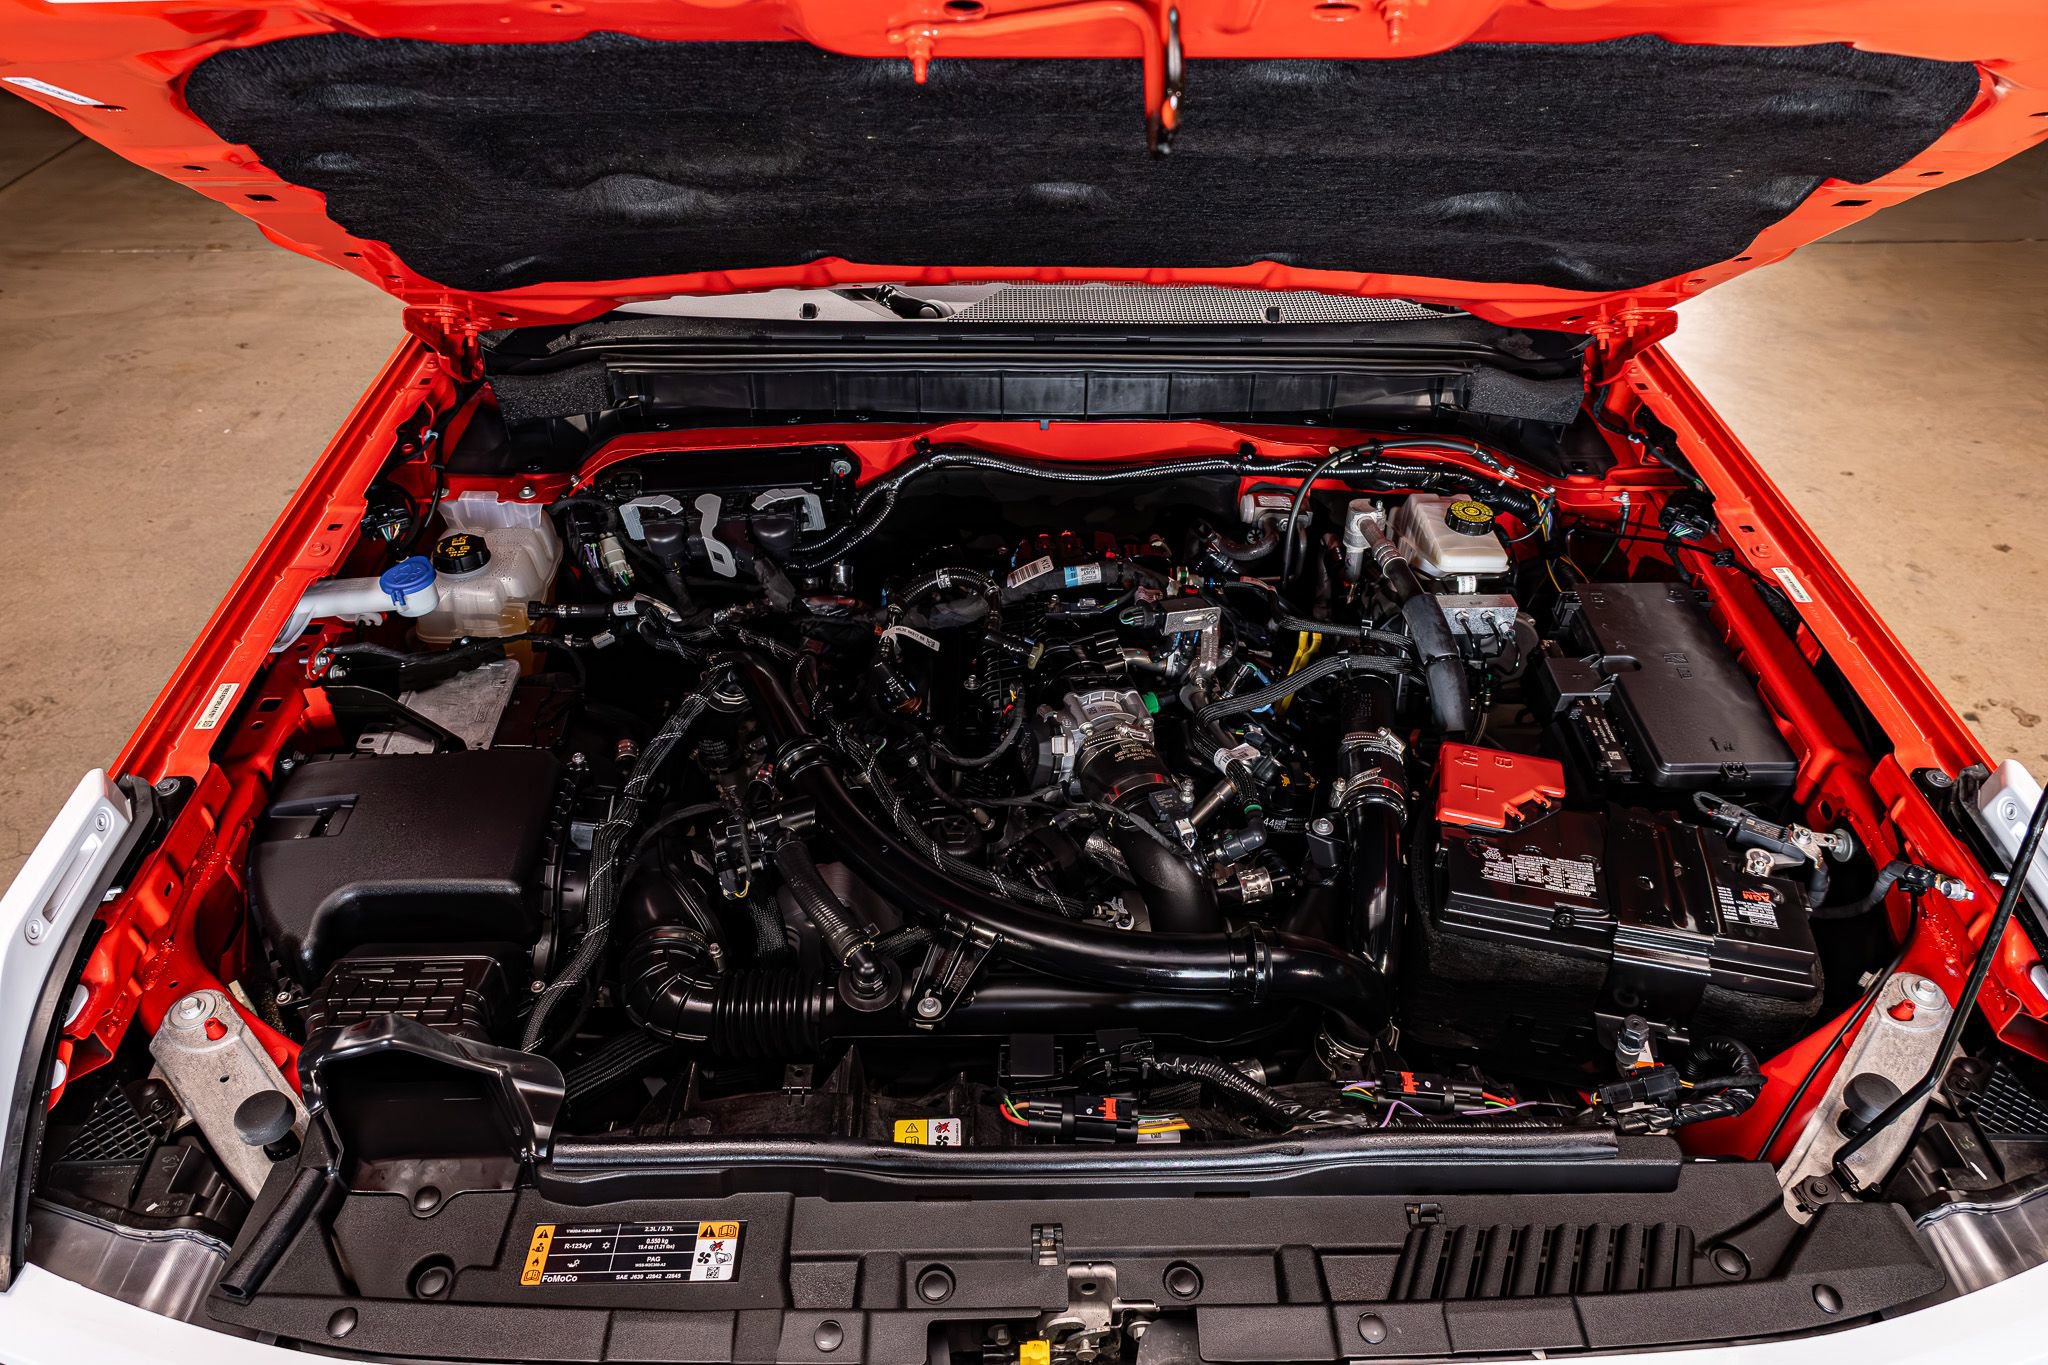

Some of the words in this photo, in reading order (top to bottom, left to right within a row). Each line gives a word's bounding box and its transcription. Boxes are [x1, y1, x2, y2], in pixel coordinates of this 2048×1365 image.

[1743, 893, 1770, 903] AGM
[564, 1242, 592, 1250] R-1234yf
[541, 1274, 578, 1283] FoMoCo
